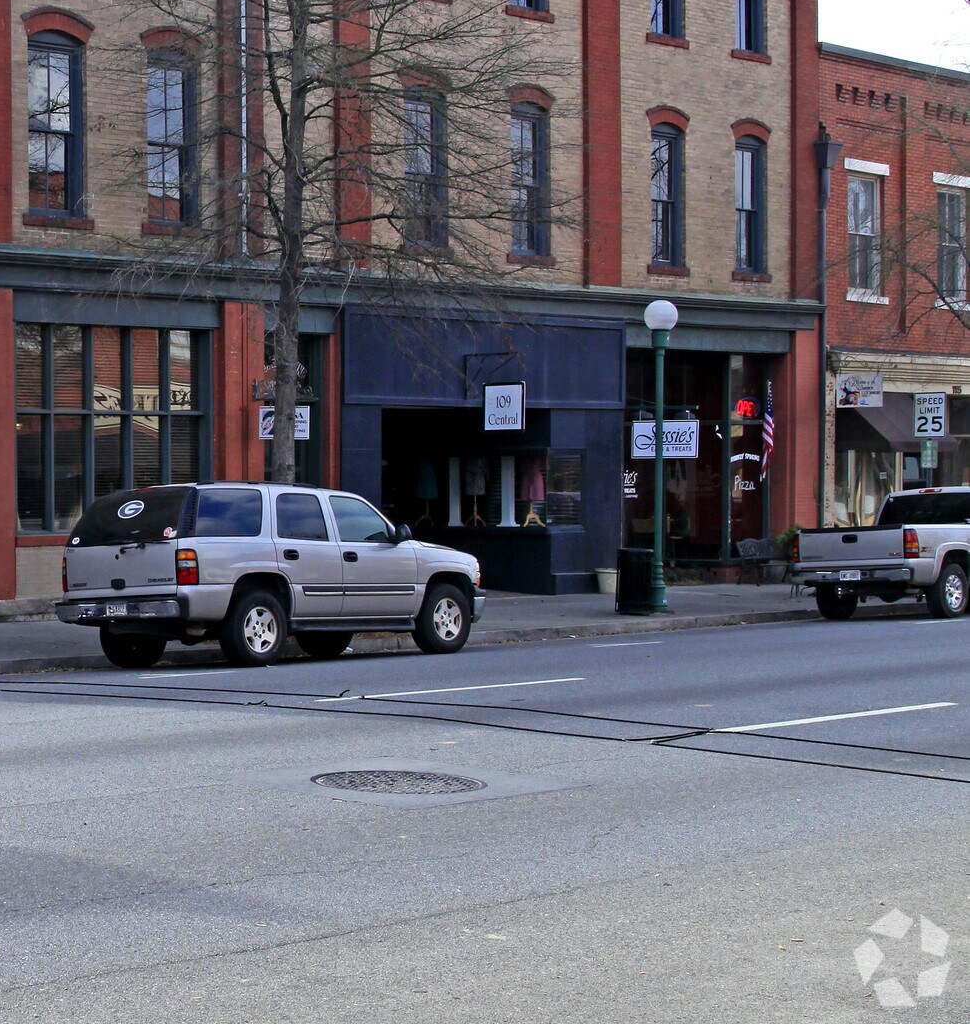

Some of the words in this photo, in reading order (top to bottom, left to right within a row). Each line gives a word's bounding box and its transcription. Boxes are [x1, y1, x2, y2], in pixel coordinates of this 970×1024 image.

[496, 395, 511, 408] 109
[917, 397, 943, 405] SPEED
[488, 413, 518, 425] Central
[917, 416, 942, 432] 25
[734, 475, 756, 491] Pizza
